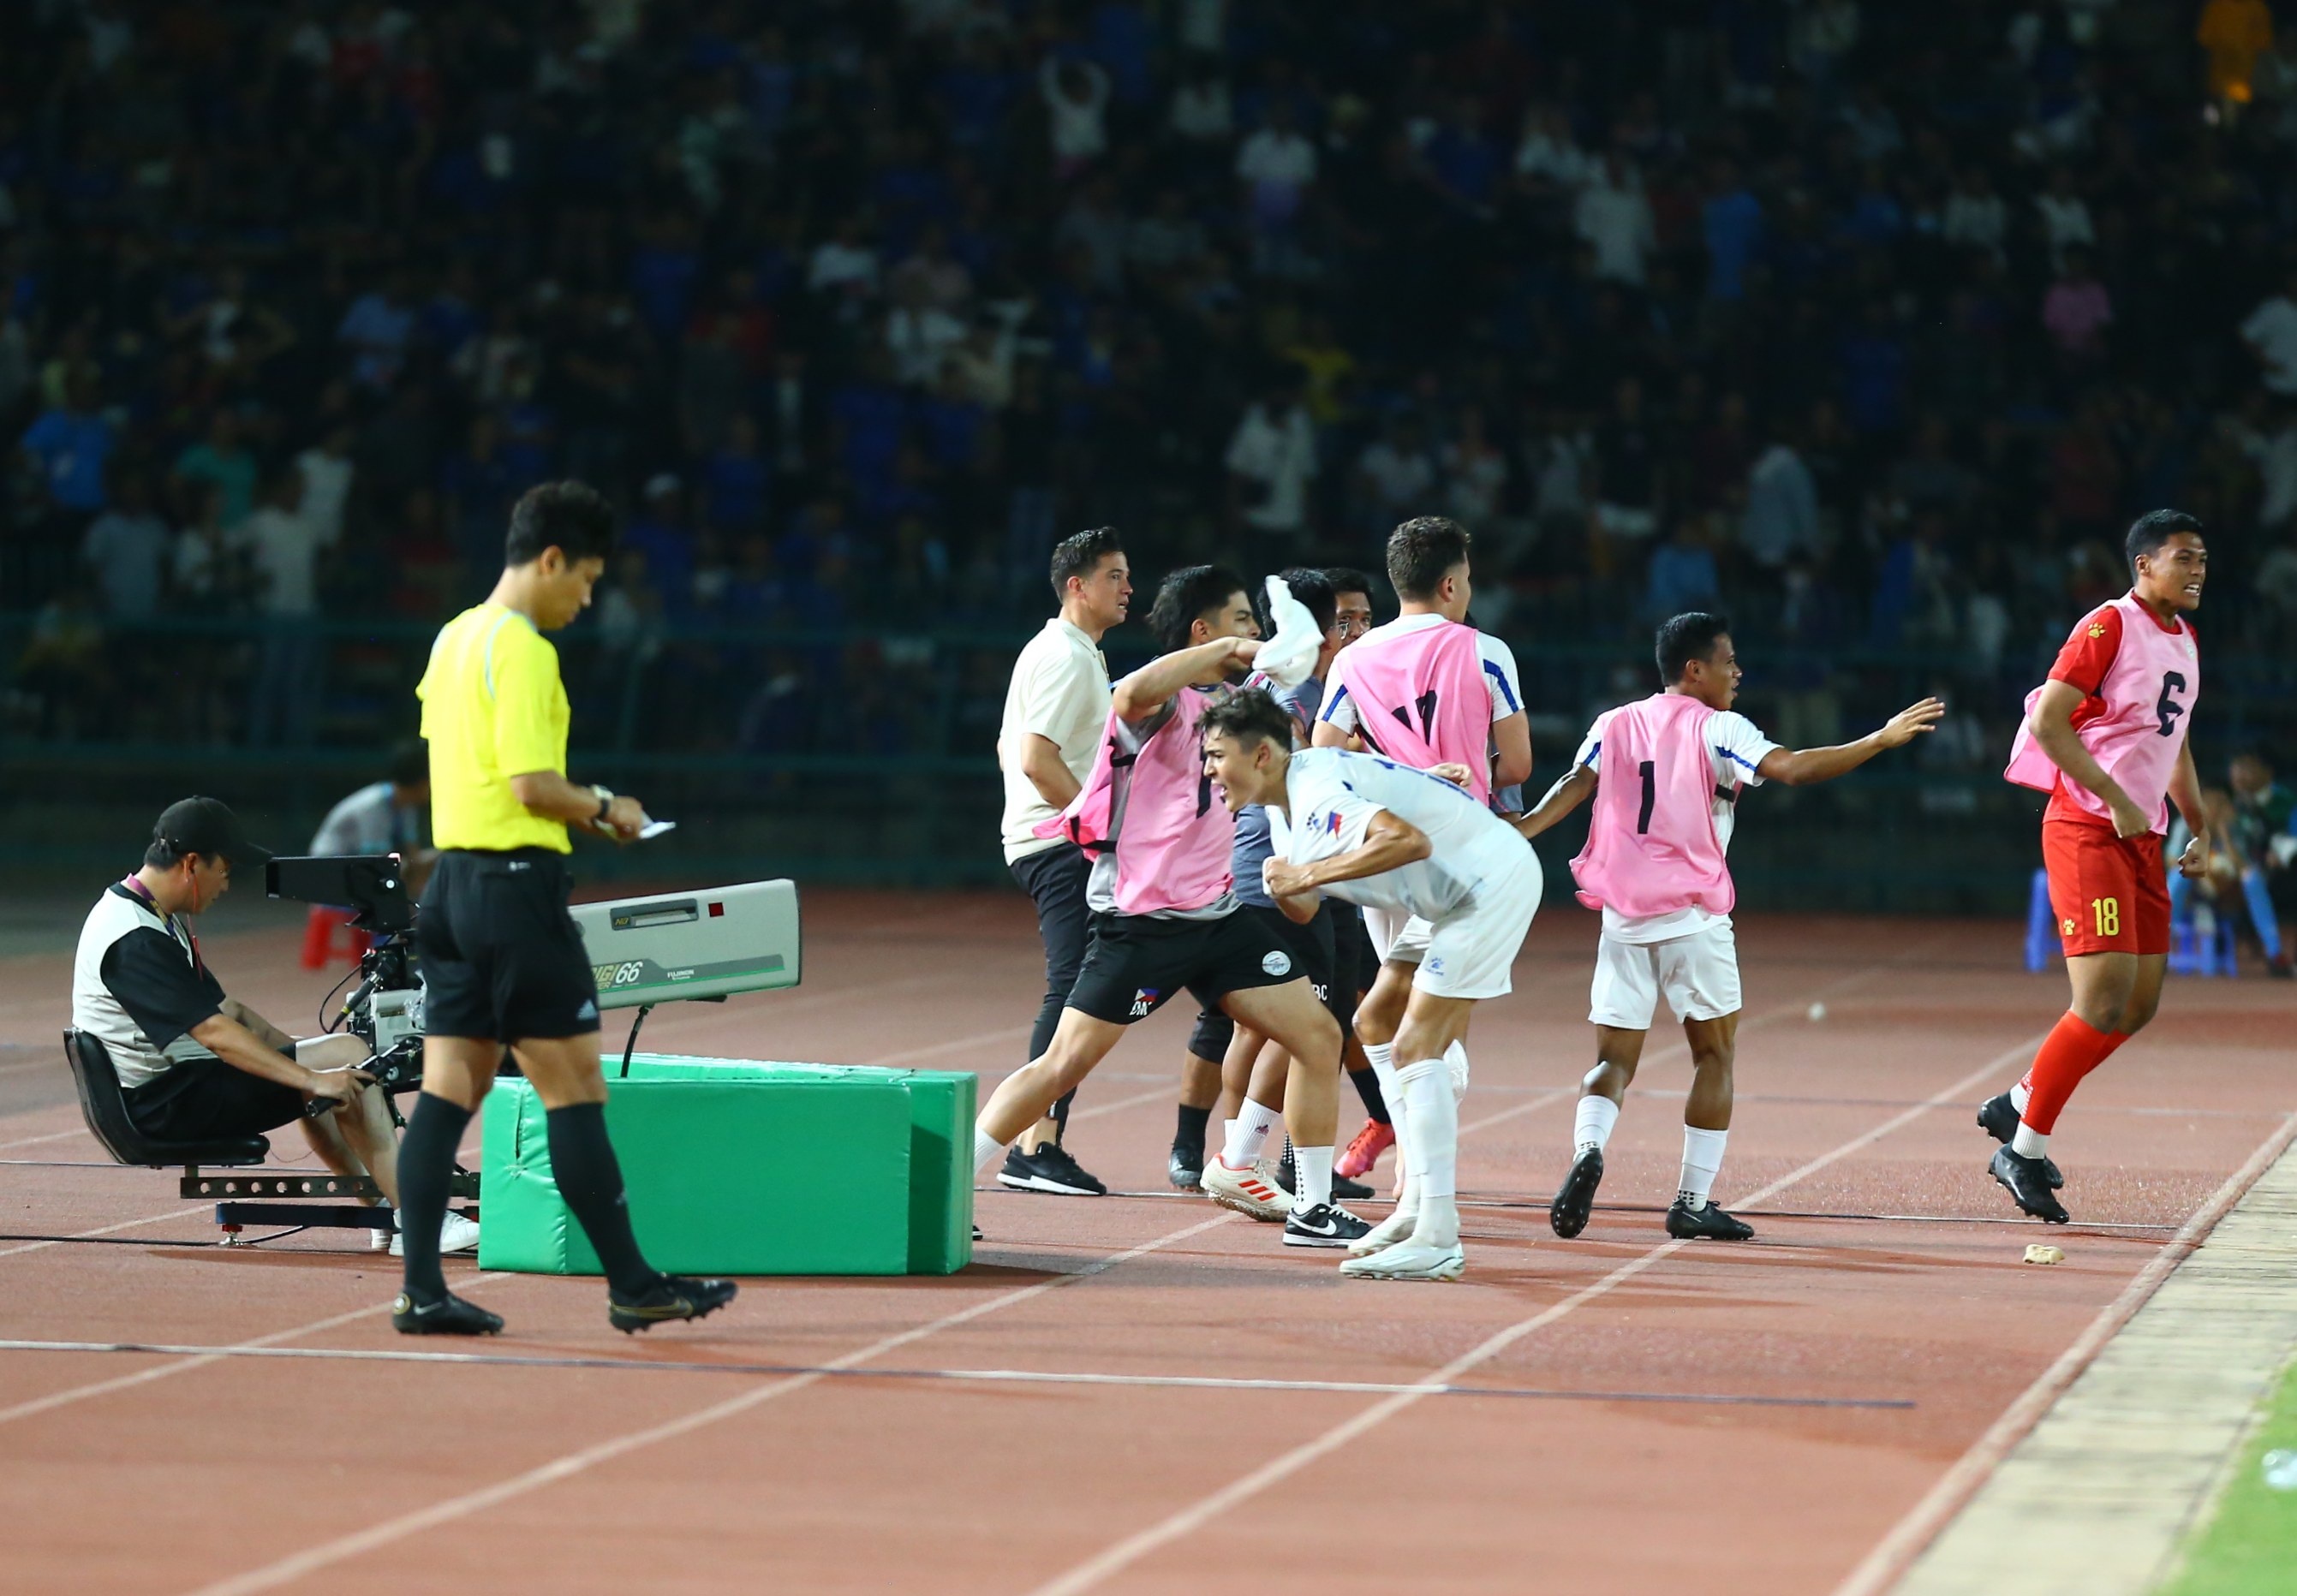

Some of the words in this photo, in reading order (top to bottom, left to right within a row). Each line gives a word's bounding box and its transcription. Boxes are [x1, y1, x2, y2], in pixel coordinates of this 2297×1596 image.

[2157, 670, 2187, 737] 6
[1638, 760, 1656, 835] 1
[2091, 896, 2120, 937] 18
